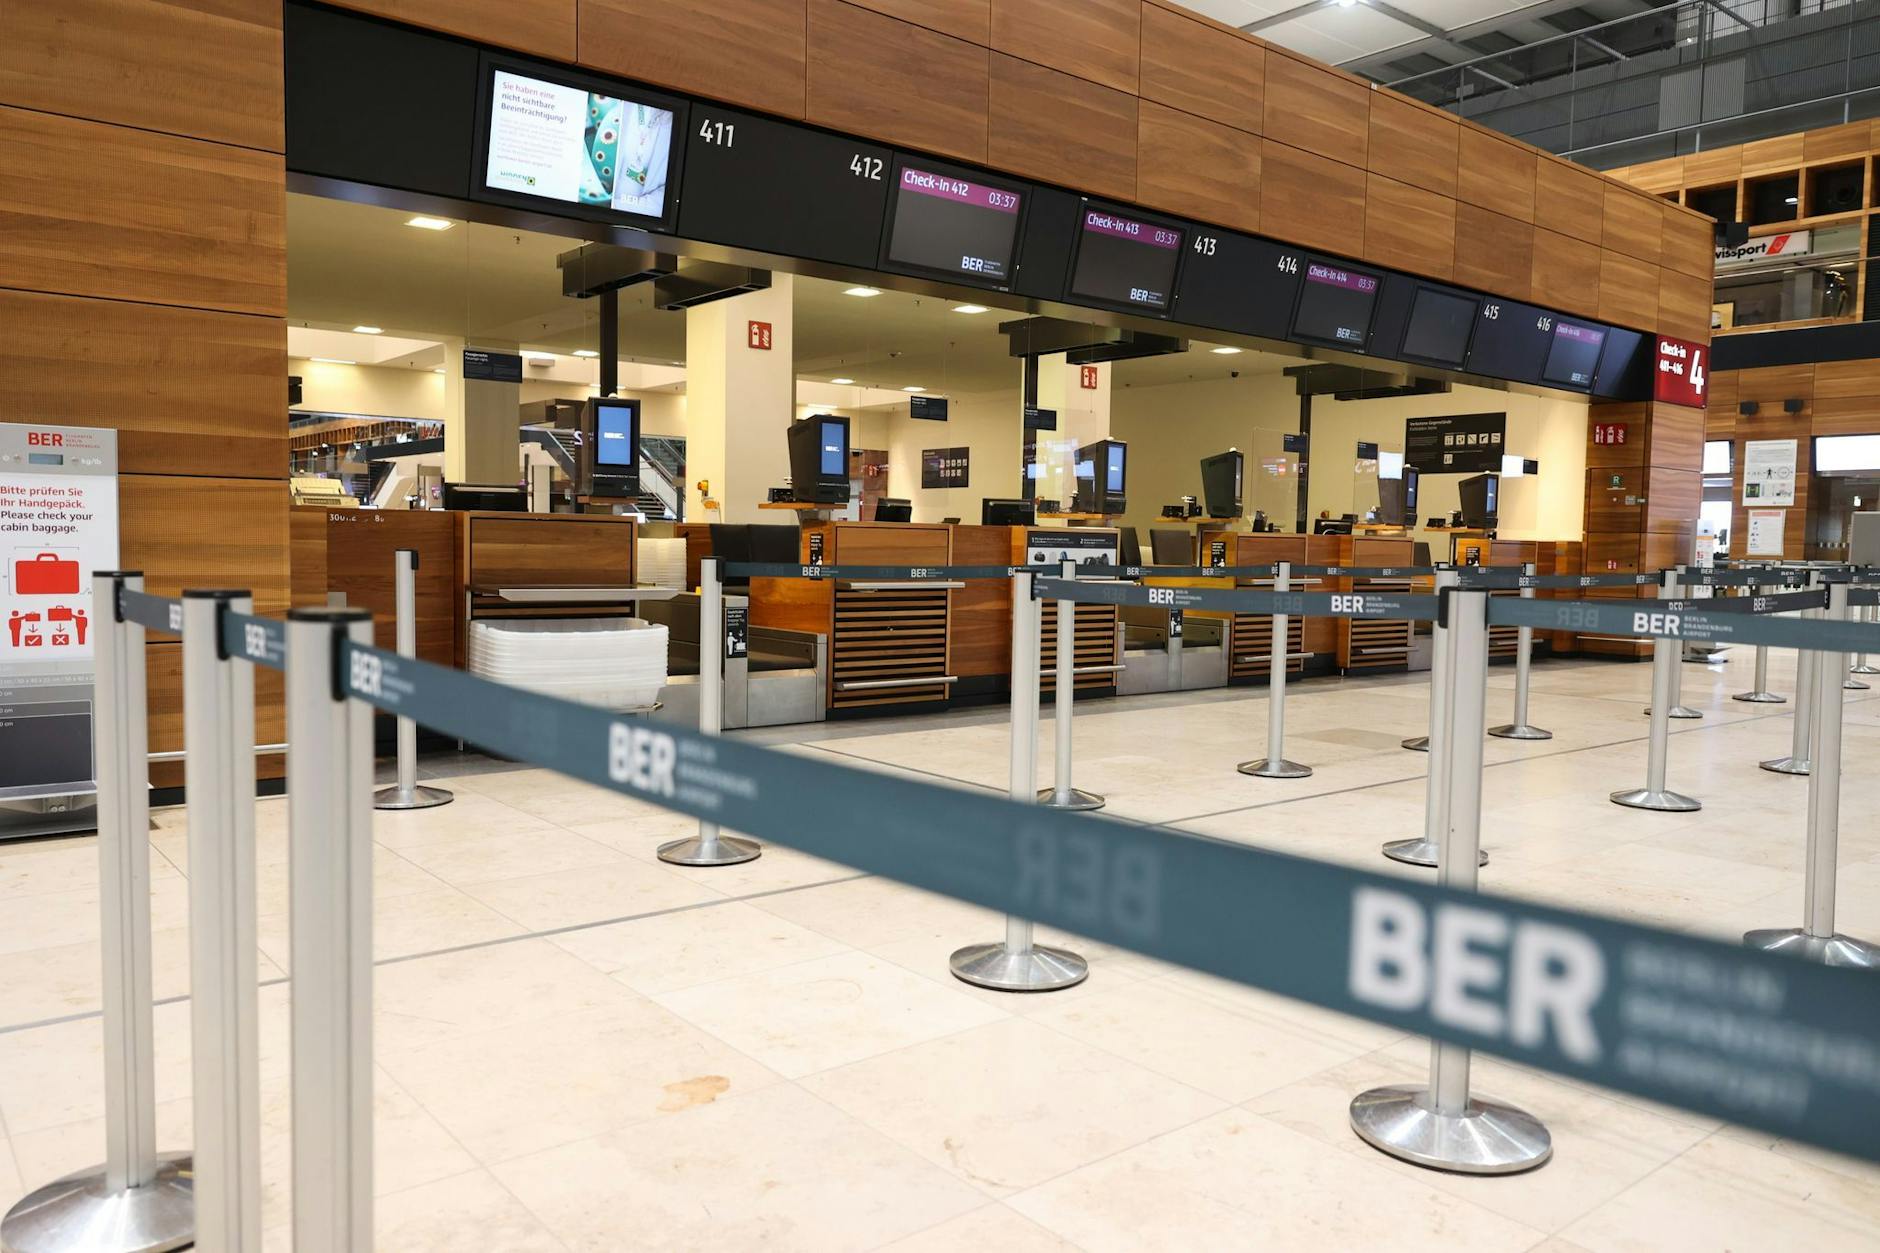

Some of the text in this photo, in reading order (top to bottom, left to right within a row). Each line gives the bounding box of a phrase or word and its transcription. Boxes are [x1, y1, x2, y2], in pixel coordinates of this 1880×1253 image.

[503, 82, 555, 99] Sie haben eine
[502, 92, 555, 110] nicht sichtbare
[700, 119, 734, 147] 411
[850, 154, 883, 180] 412
[904, 171, 1016, 208] Check-In 412 03:37
[1088, 214, 1178, 245] Check-In 413 03:37
[1194, 236, 1216, 256] 413
[962, 256, 984, 272] BER
[1278, 256, 1297, 274] 414
[1130, 288, 1148, 301] BER
[1484, 305, 1499, 320] 415
[1536, 316, 1550, 332] 416
[1336, 328, 1350, 338] BER
[1690, 350, 1704, 394] 4
[28, 432, 62, 446] BER
[0, 486, 83, 496] Bitte prüfen Sie
[20, 500, 84, 510] Handgepäck.
[1, 511, 93, 522] Please check your
[0, 523, 78, 534] cabin baggage.
[802, 566, 820, 576] BER
[911, 568, 927, 578] BER
[1126, 567, 1140, 576] BER
[1202, 568, 1214, 576] BER
[1519, 577, 1530, 586] BER
[1580, 576, 1590, 586] BER
[1636, 575, 1646, 584] BER
[1149, 588, 1174, 604] BER
[1331, 596, 1364, 613] BER
[1754, 598, 1766, 611] BER
[1633, 612, 1679, 636] BER
[1684, 624, 1733, 632] BRANDENBURG
[350, 650, 382, 697] BER
[609, 722, 677, 798] BER
[1349, 886, 1608, 1065] BER
